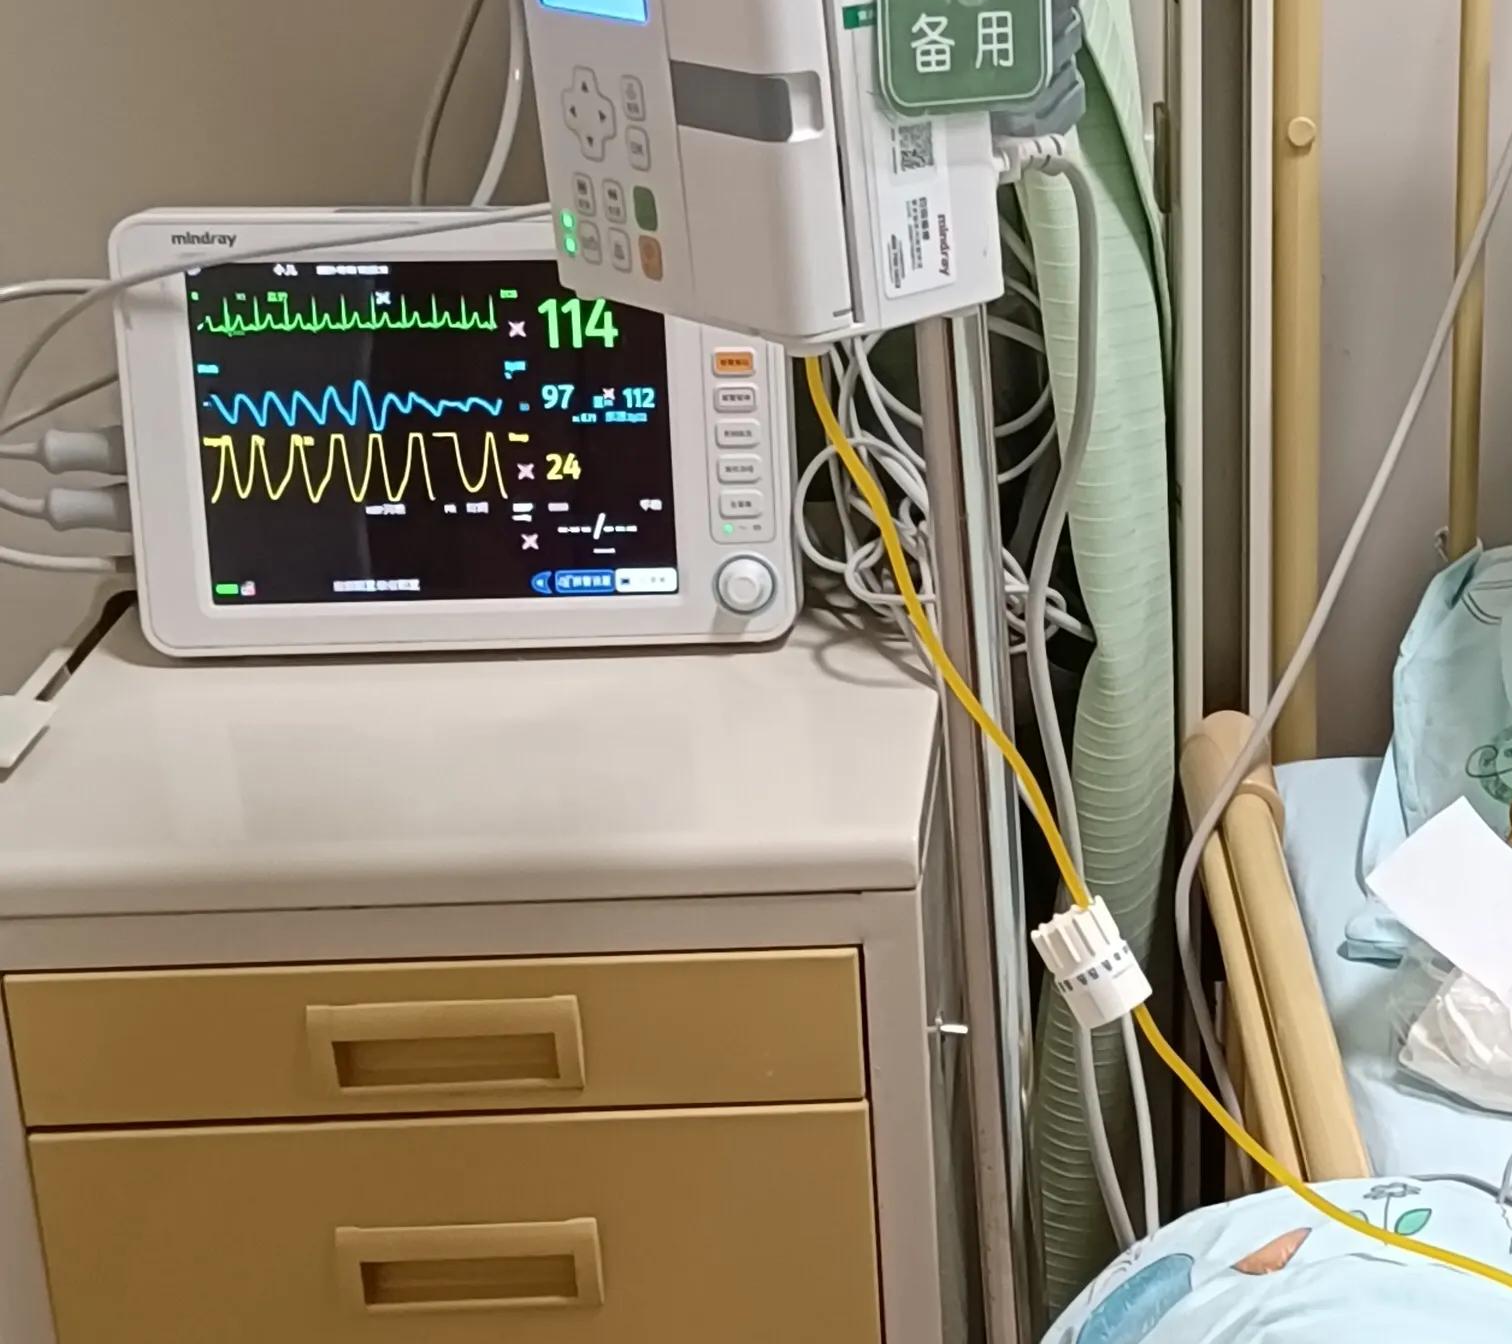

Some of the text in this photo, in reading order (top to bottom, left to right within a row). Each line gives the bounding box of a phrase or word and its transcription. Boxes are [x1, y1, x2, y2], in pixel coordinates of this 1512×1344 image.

[910, 11, 1014, 73] 备用
[171, 232, 237, 247] mindray
[537, 297, 619, 349] 114
[541, 384, 575, 409] 97
[622, 387, 656, 408] 112
[546, 453, 582, 481] 24
